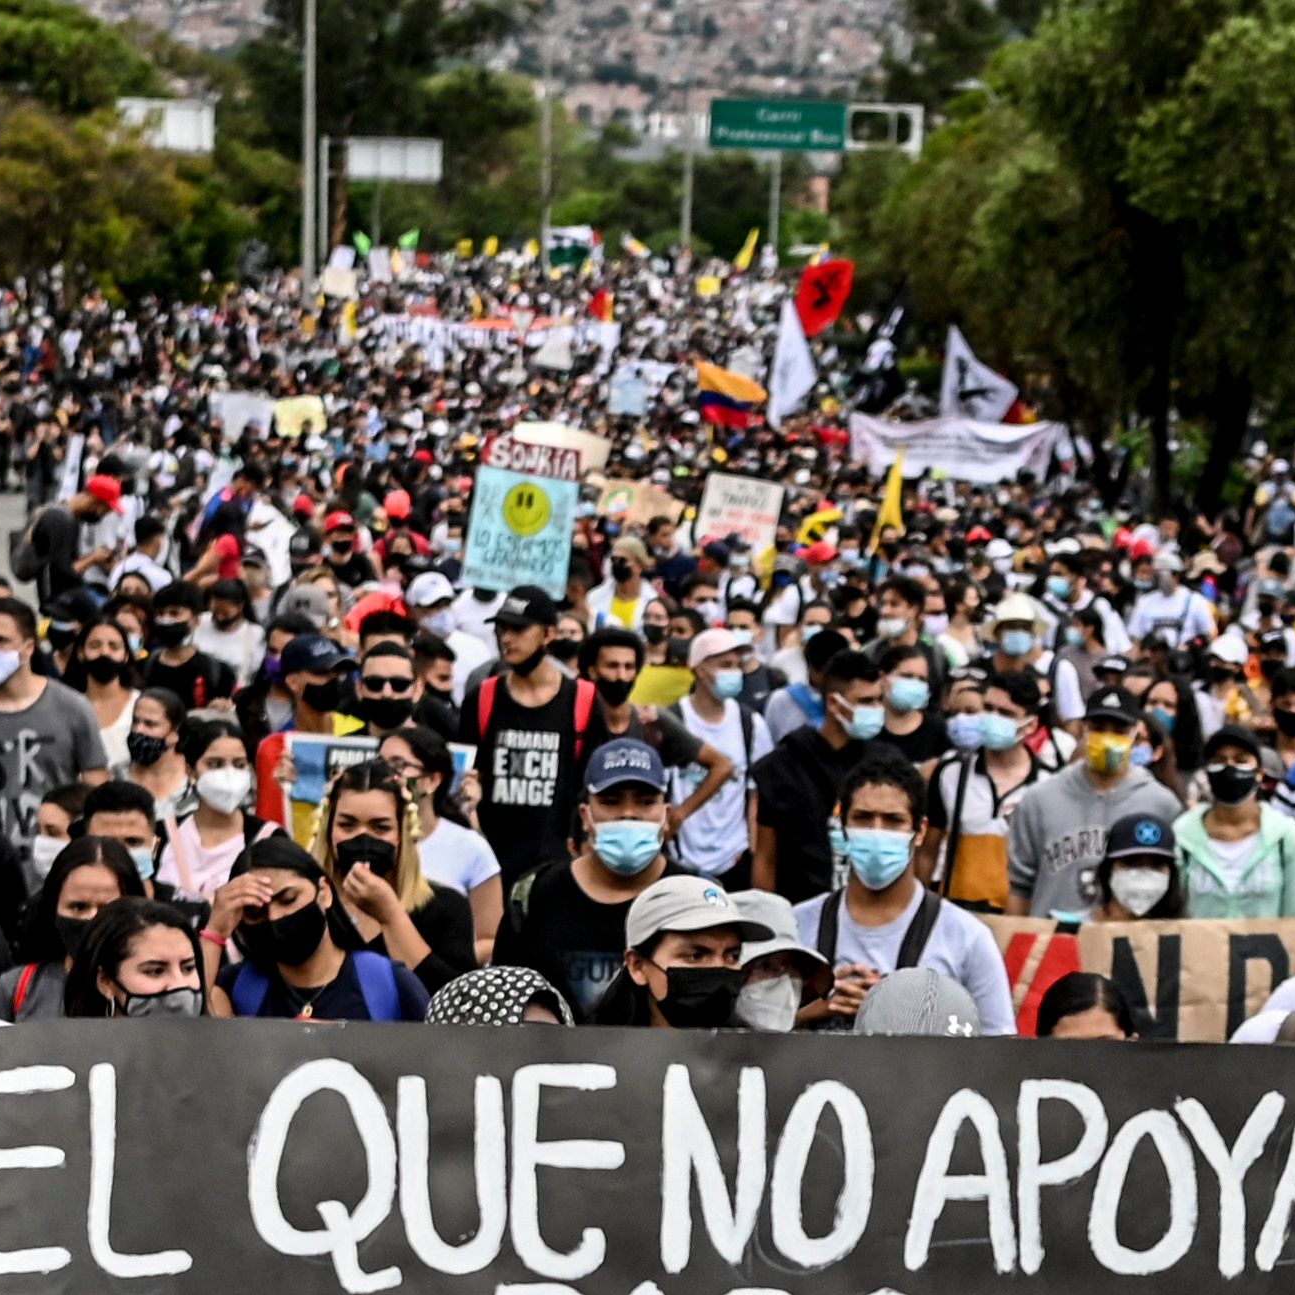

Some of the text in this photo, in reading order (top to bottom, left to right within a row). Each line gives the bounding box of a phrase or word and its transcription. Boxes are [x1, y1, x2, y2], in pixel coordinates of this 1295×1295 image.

[497, 730, 559, 750] ARMANI
[493, 748, 558, 778] EXCH
[492, 777, 556, 807] ANGE
[249, 1059, 624, 1294] QUE
[661, 1064, 874, 1272] NO
